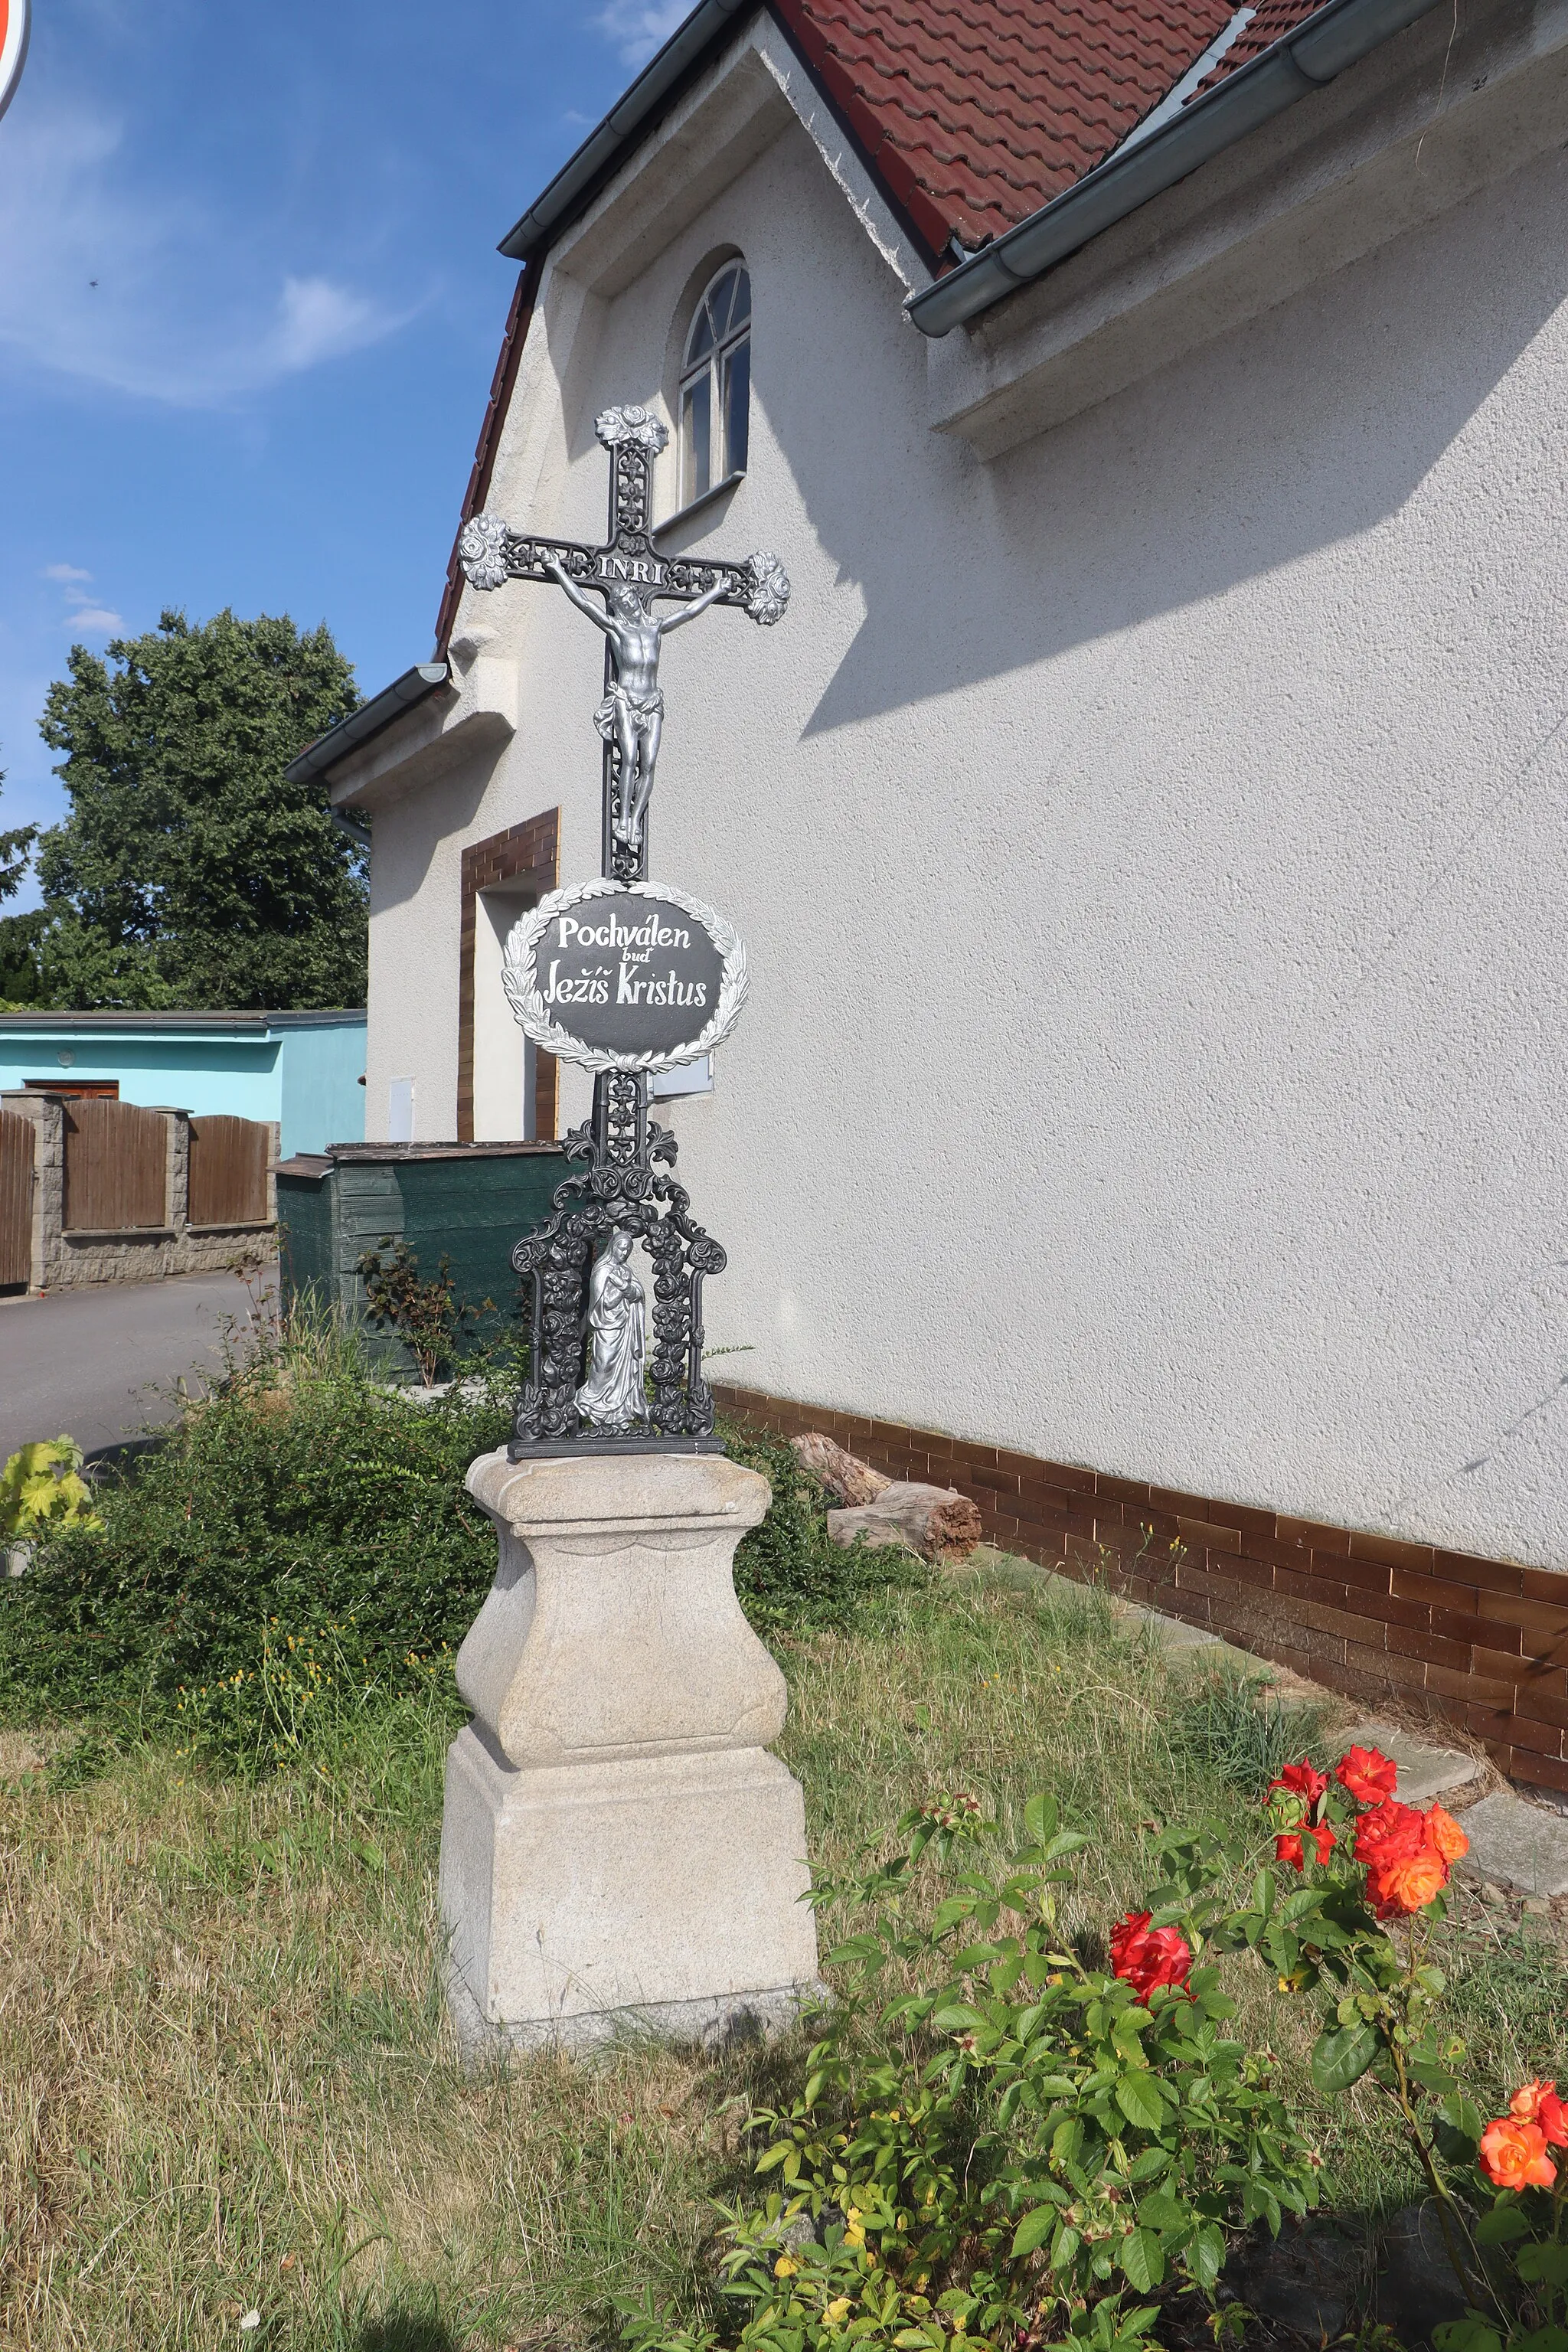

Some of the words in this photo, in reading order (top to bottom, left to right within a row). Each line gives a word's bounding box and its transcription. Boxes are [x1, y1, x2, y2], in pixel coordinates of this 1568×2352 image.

[599, 556, 663, 585] INRI
[557, 913, 691, 949] Pochválen
[543, 959, 613, 1004] Ježíš
[615, 962, 707, 1007] Kristus
